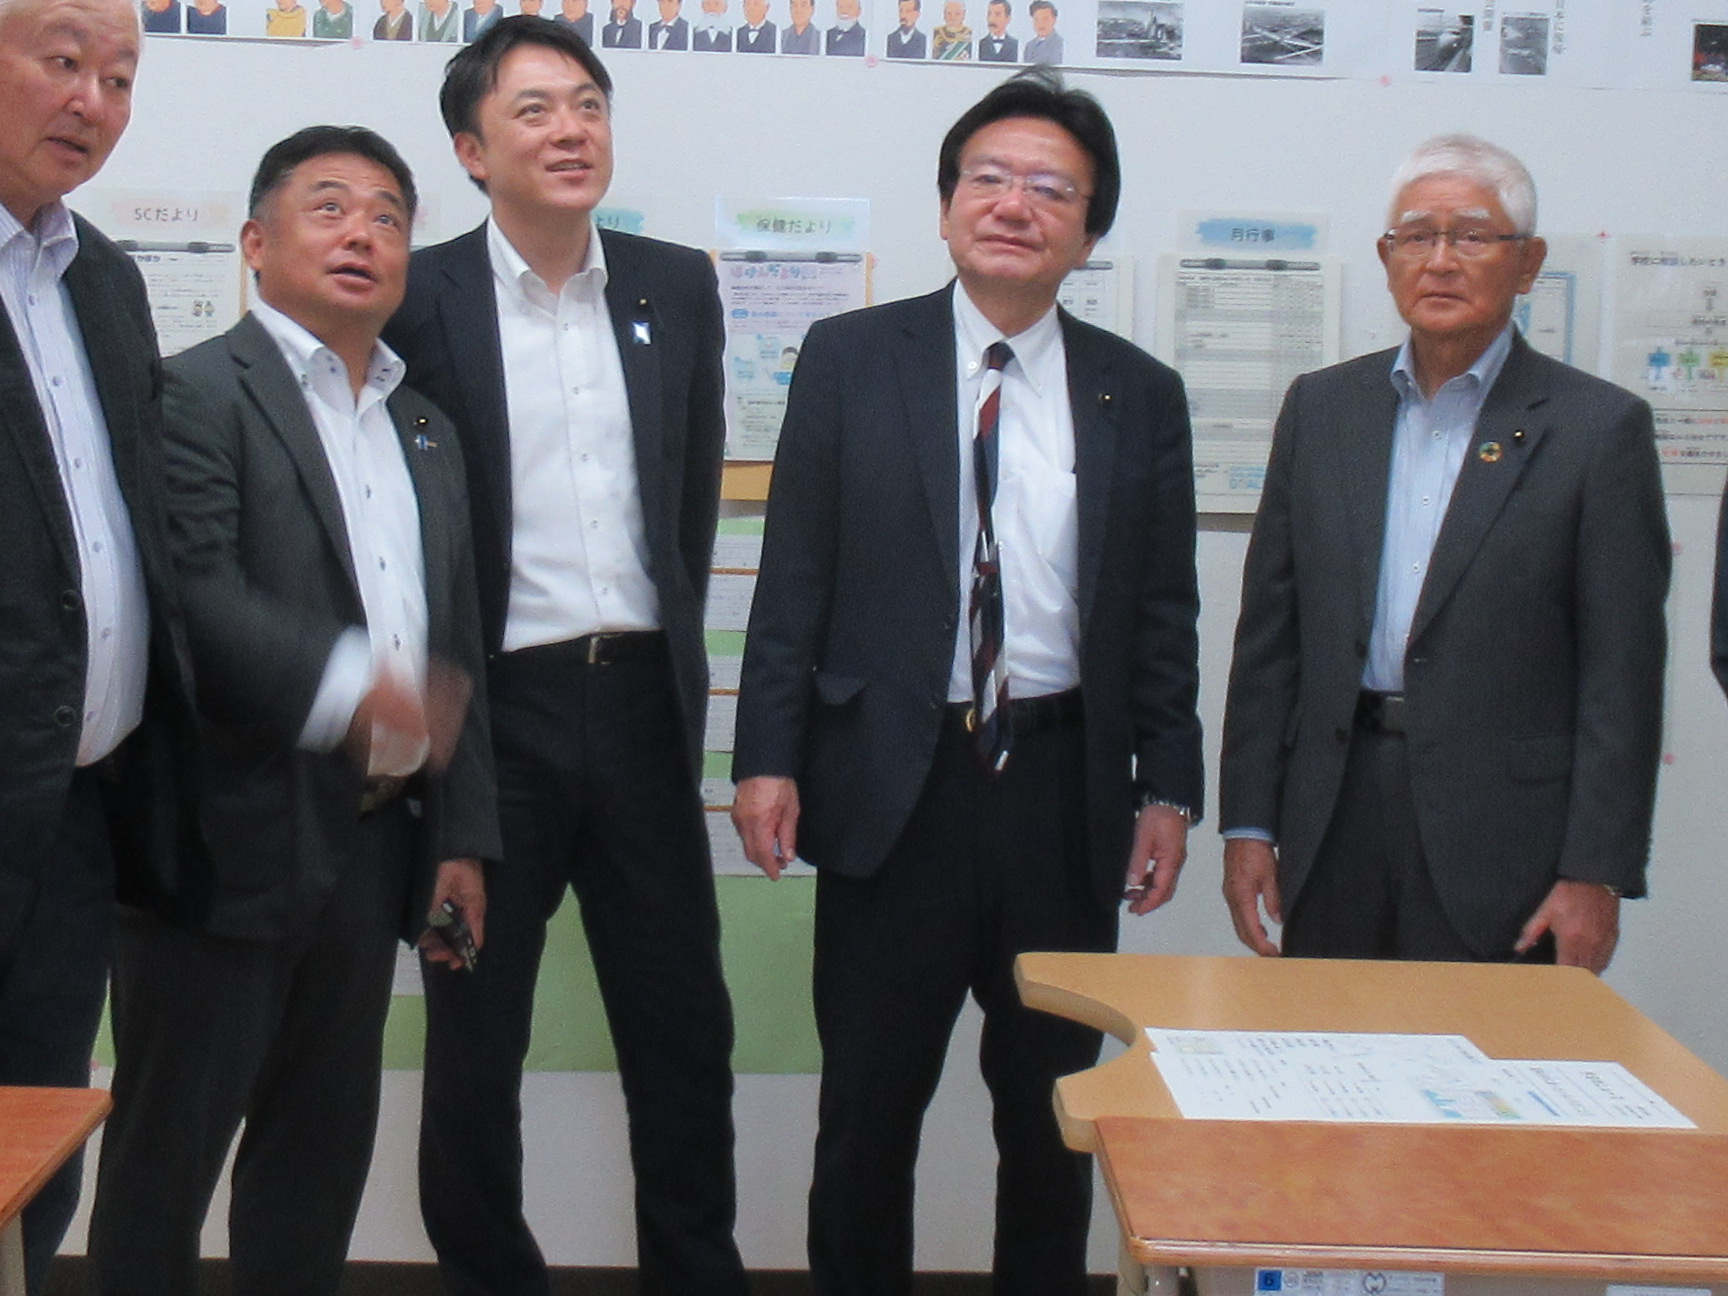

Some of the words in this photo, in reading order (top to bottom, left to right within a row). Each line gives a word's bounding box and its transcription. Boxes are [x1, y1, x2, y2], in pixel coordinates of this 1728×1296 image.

[134, 207, 199, 222] SCだより
[756, 218, 832, 234] 保健だより
[1229, 227, 1276, 243] 月行事
